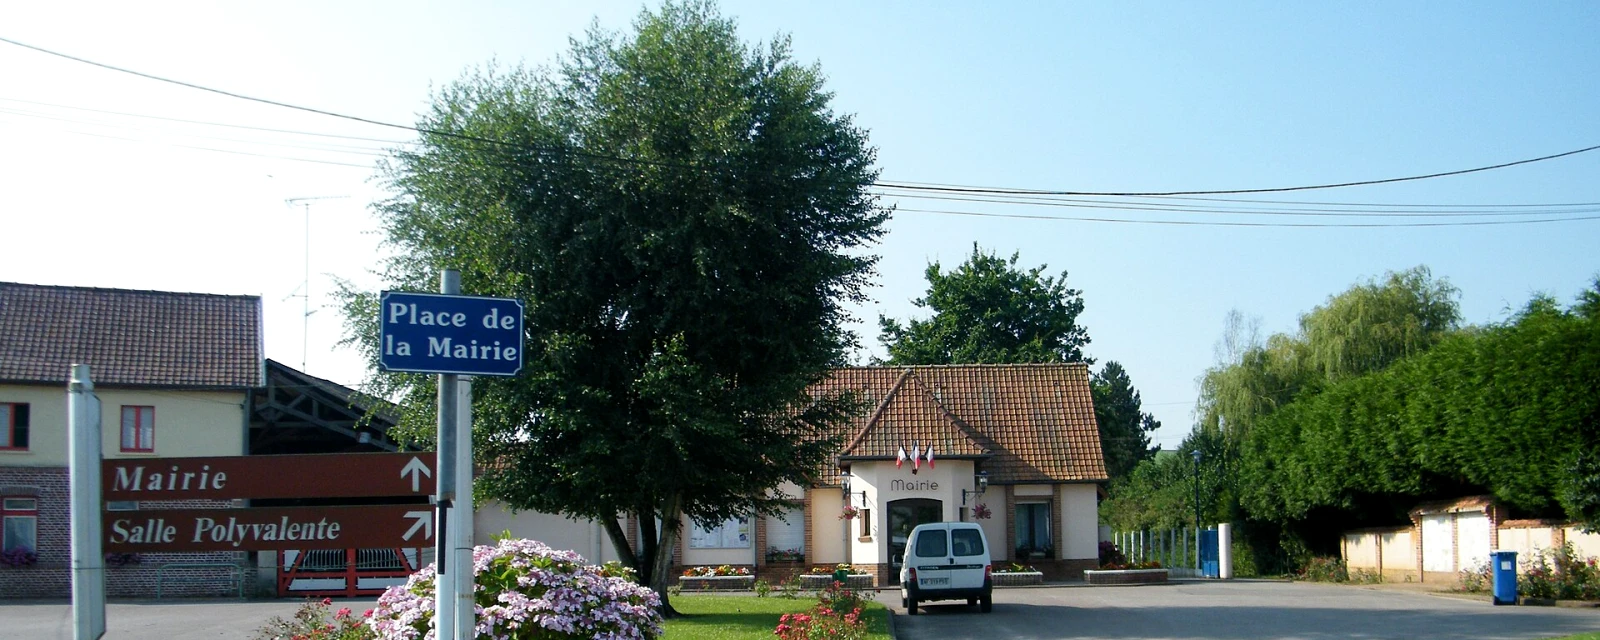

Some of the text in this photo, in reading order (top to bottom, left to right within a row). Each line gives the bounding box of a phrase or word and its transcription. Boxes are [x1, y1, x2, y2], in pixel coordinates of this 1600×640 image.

[389, 303, 515, 330] Place de
[385, 335, 517, 361] la Mairie
[112, 465, 227, 492] Mairie
[890, 479, 939, 491] Mairie
[110, 516, 341, 547] Salle Polyvalente
